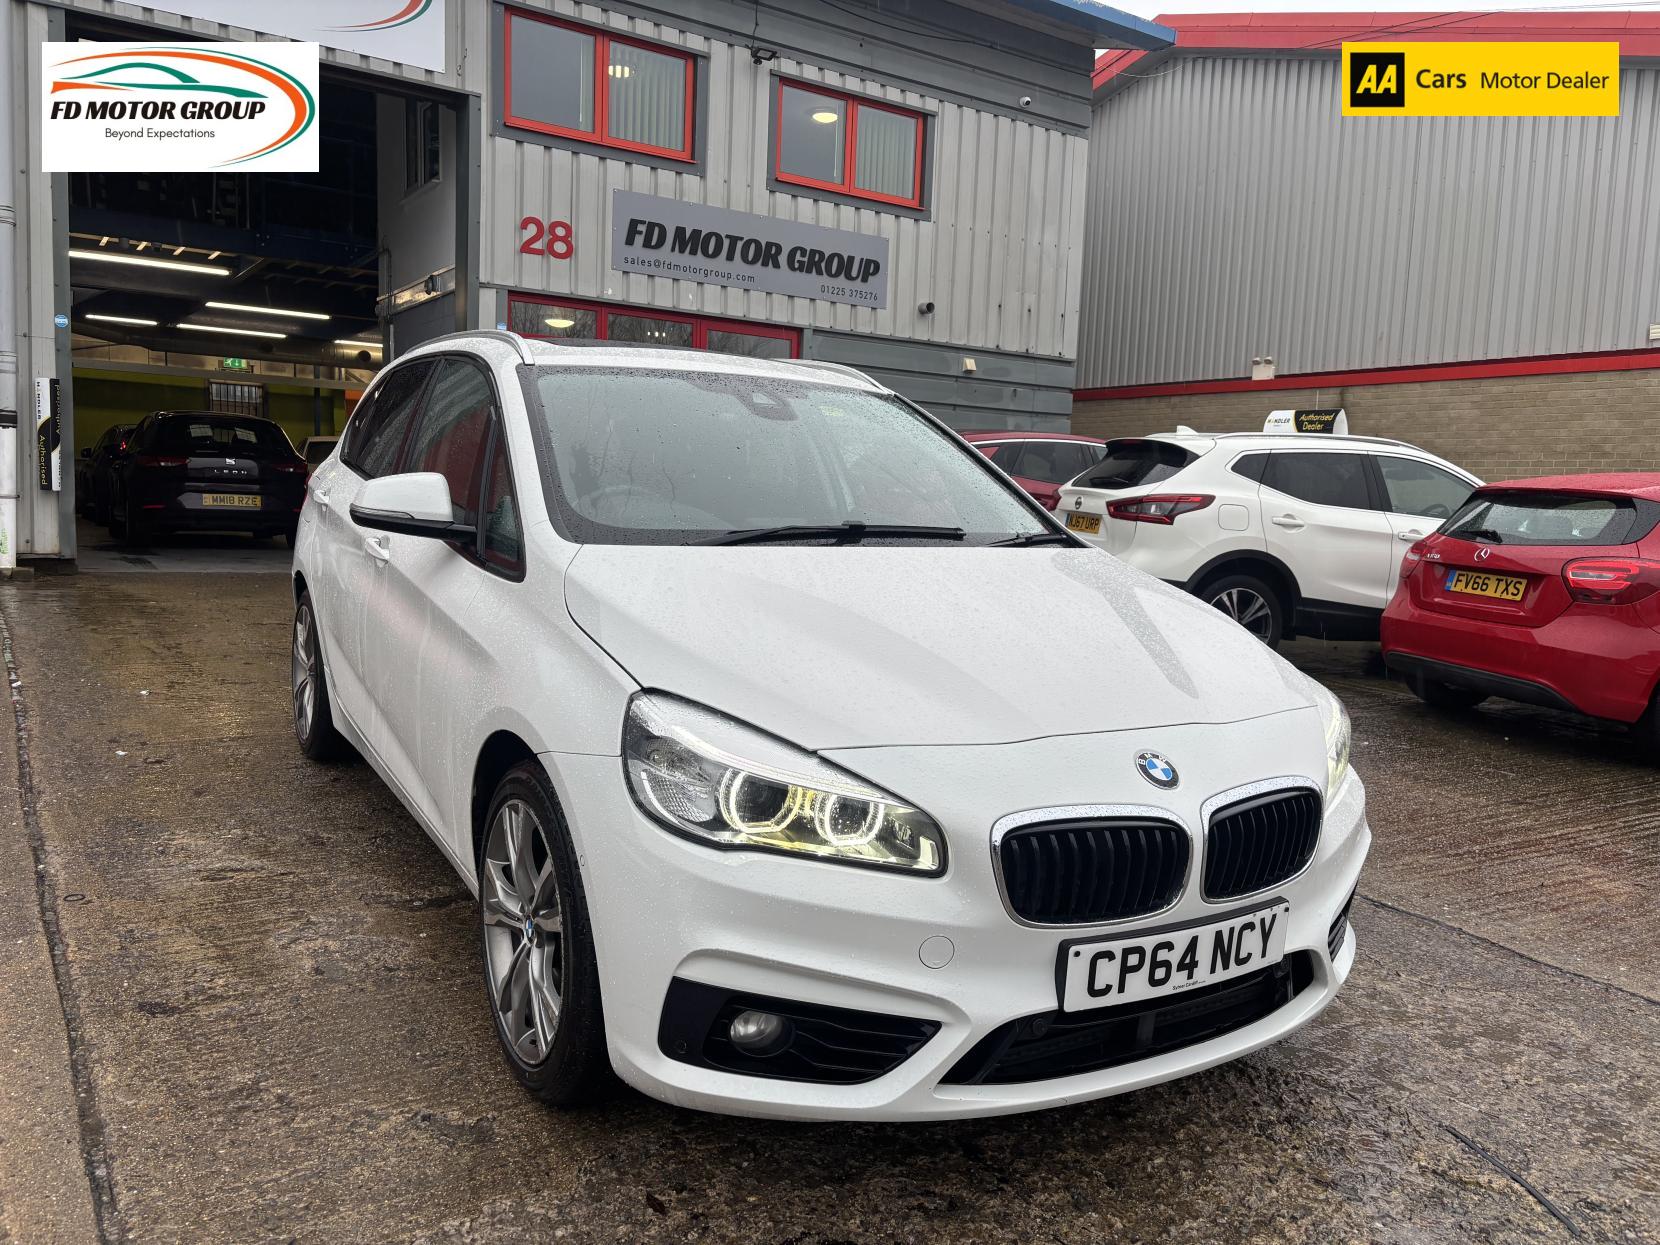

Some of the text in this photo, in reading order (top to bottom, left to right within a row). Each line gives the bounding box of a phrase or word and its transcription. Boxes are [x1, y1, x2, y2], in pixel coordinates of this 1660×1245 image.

[519, 216, 574, 260] 28
[624, 218, 881, 283] FD MOTOR GROUP
[623, 255, 755, 283] sales@fdmotorgroup.com
[820, 285, 878, 301] 01225 375276
[1299, 412, 1335, 421] Authorised
[1302, 421, 1324, 431] Dealer
[39, 434, 47, 485] Authorised
[238, 496, 258, 505] RZE
[1454, 573, 1523, 597] FV66 TXS
[1086, 913, 1278, 998] CP64 NCY
